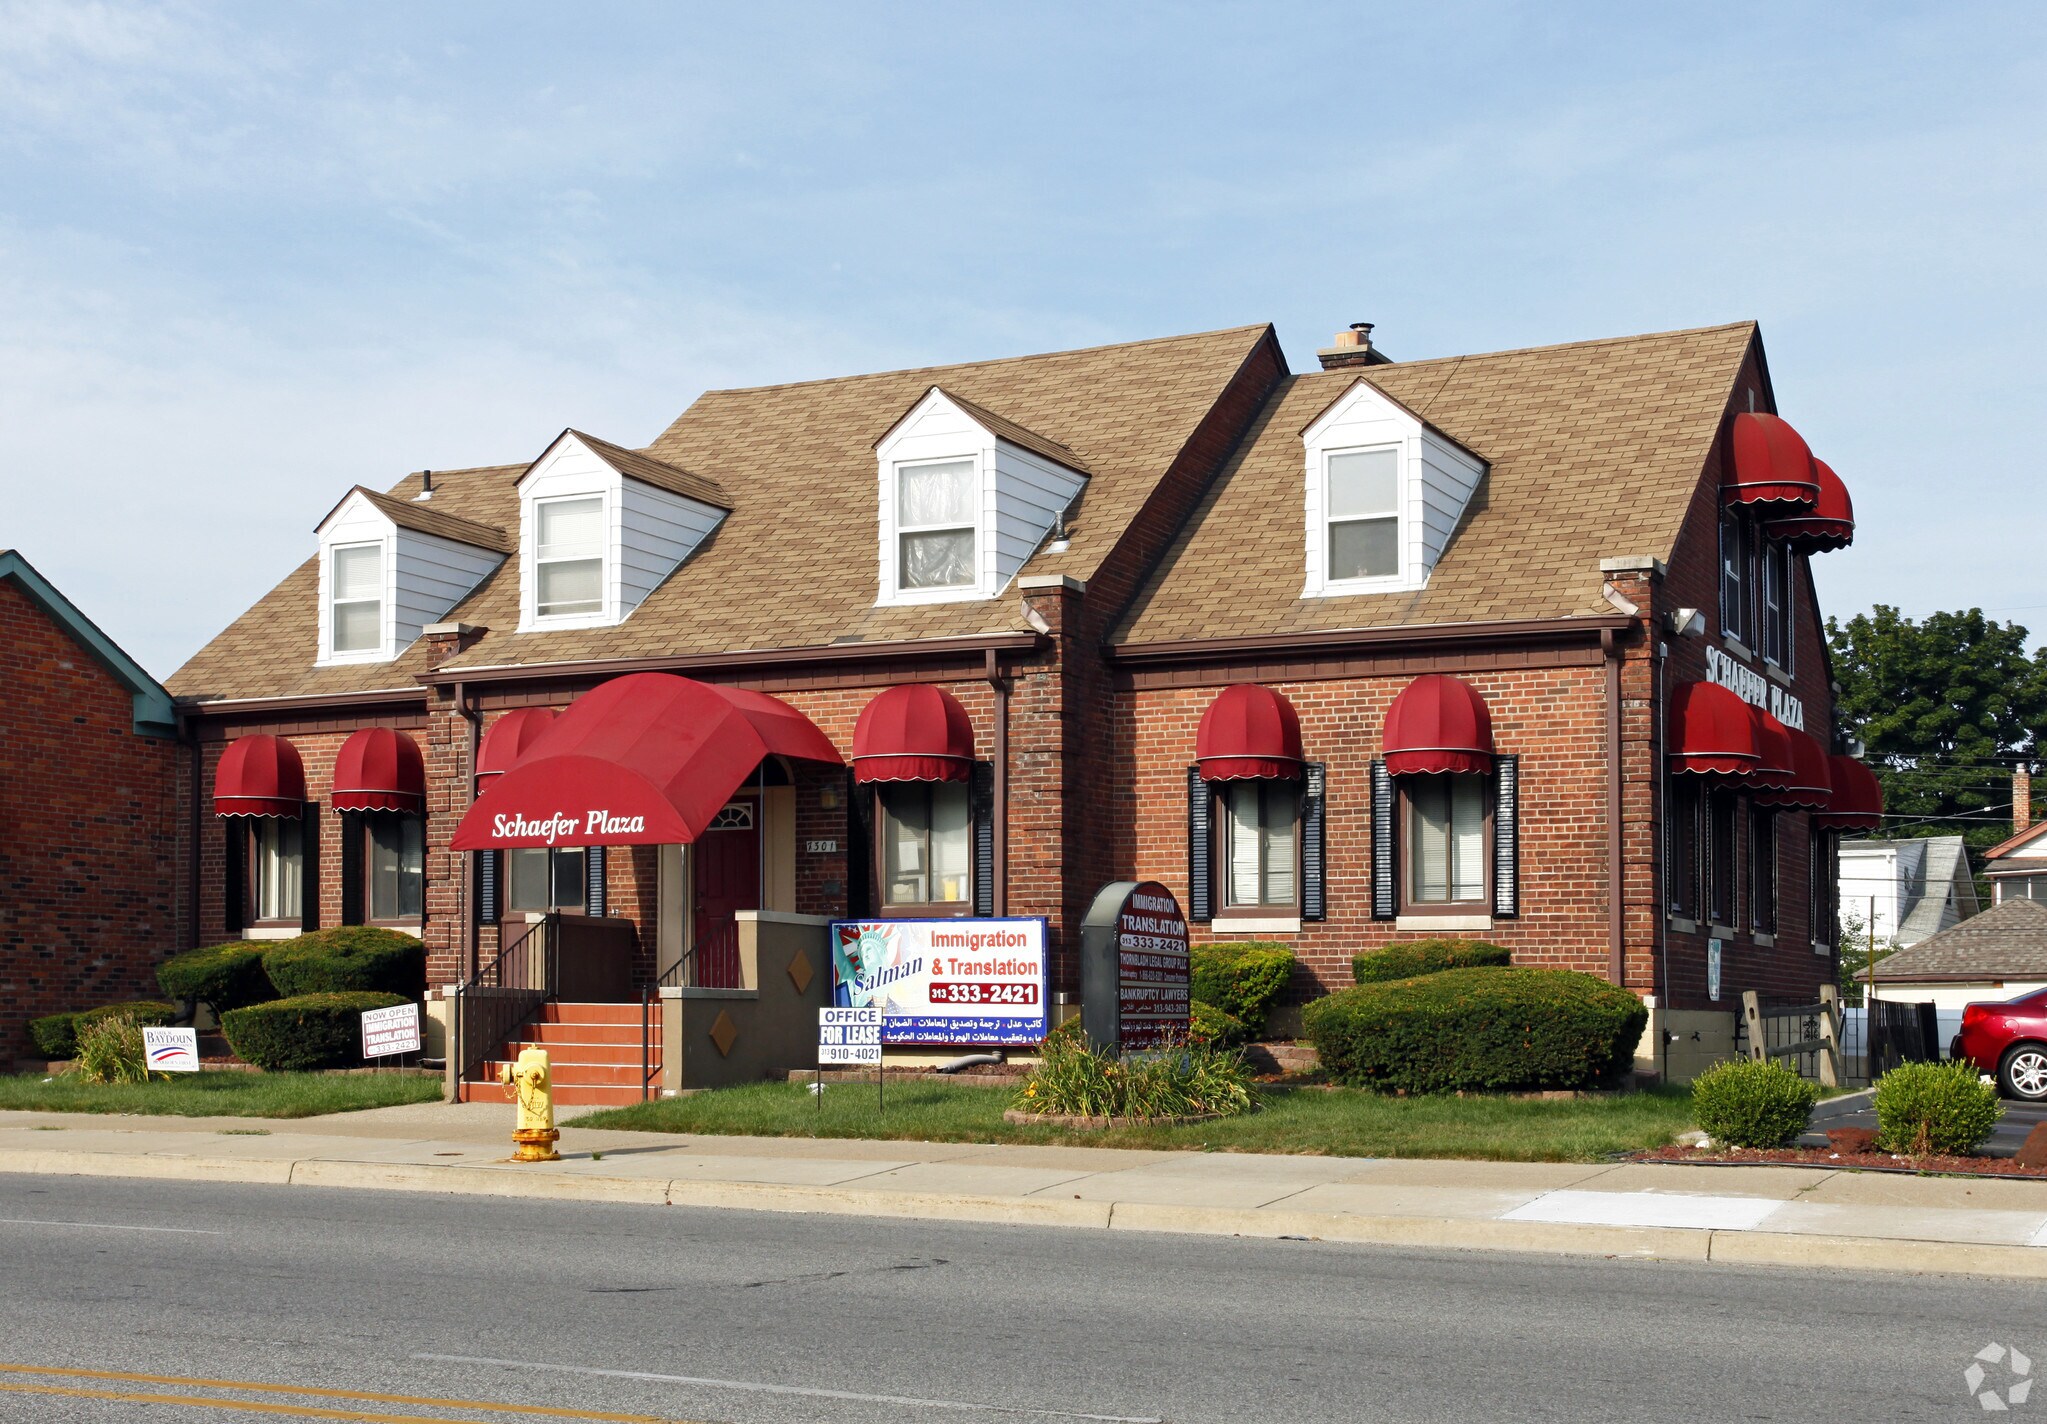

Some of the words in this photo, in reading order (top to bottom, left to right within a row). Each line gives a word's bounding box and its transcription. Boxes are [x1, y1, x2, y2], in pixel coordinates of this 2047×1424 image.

[1705, 645, 1767, 710] SCHAEFER
[1770, 684, 1804, 732] PLAZA
[492, 812, 579, 845] Schaefer
[584, 810, 645, 835] Plaza
[1132, 894, 1174, 913] IMMIGRATION
[1121, 914, 1184, 936] TRANSLATION
[931, 930, 1027, 951] Immigration
[1121, 937, 1131, 945] 313
[1133, 936, 1184, 952] 333-2421
[931, 958, 943, 976] &
[948, 958, 1038, 976] Translation
[1150, 956, 1162, 968] LEGAL
[1163, 957, 1176, 969] GROUP
[853, 956, 923, 996] Salman
[931, 988, 947, 999] 313
[948, 985, 1034, 1002] 333-2421
[1120, 988, 1160, 1000] BANKRUPTCY
[1160, 989, 1188, 1001] LAWYERS
[365, 1012, 387, 1021] NOW
[388, 1007, 414, 1018] OPEN
[825, 1010, 877, 1023] OFFICE
[366, 1016, 415, 1034] IMMIGRATION
[888, 1018, 912, 1028] الضمان
[918, 1018, 948, 1028] المعاملات
[950, 1019, 978, 1030] وتصديق
[979, 1018, 1000, 1030] ترجمة
[1007, 1019, 1022, 1028] عدل
[1024, 1018, 1042, 1030] كاتب
[146, 1031, 193, 1044] BAYDOUN
[366, 1028, 415, 1045] TRANSLATION
[820, 1026, 843, 1045] FOR
[846, 1026, 880, 1045] LEASE
[886, 1032, 915, 1043] الحكومية
[916, 1032, 949, 1043] والمعاملات
[949, 1032, 971, 1043] الهجرة
[971, 1032, 999, 1041] معاملات
[1000, 1033, 1026, 1044] وتعقيب
[377, 1040, 415, 1053] 333-2421
[830, 1048, 879, 1060] 910-4021
